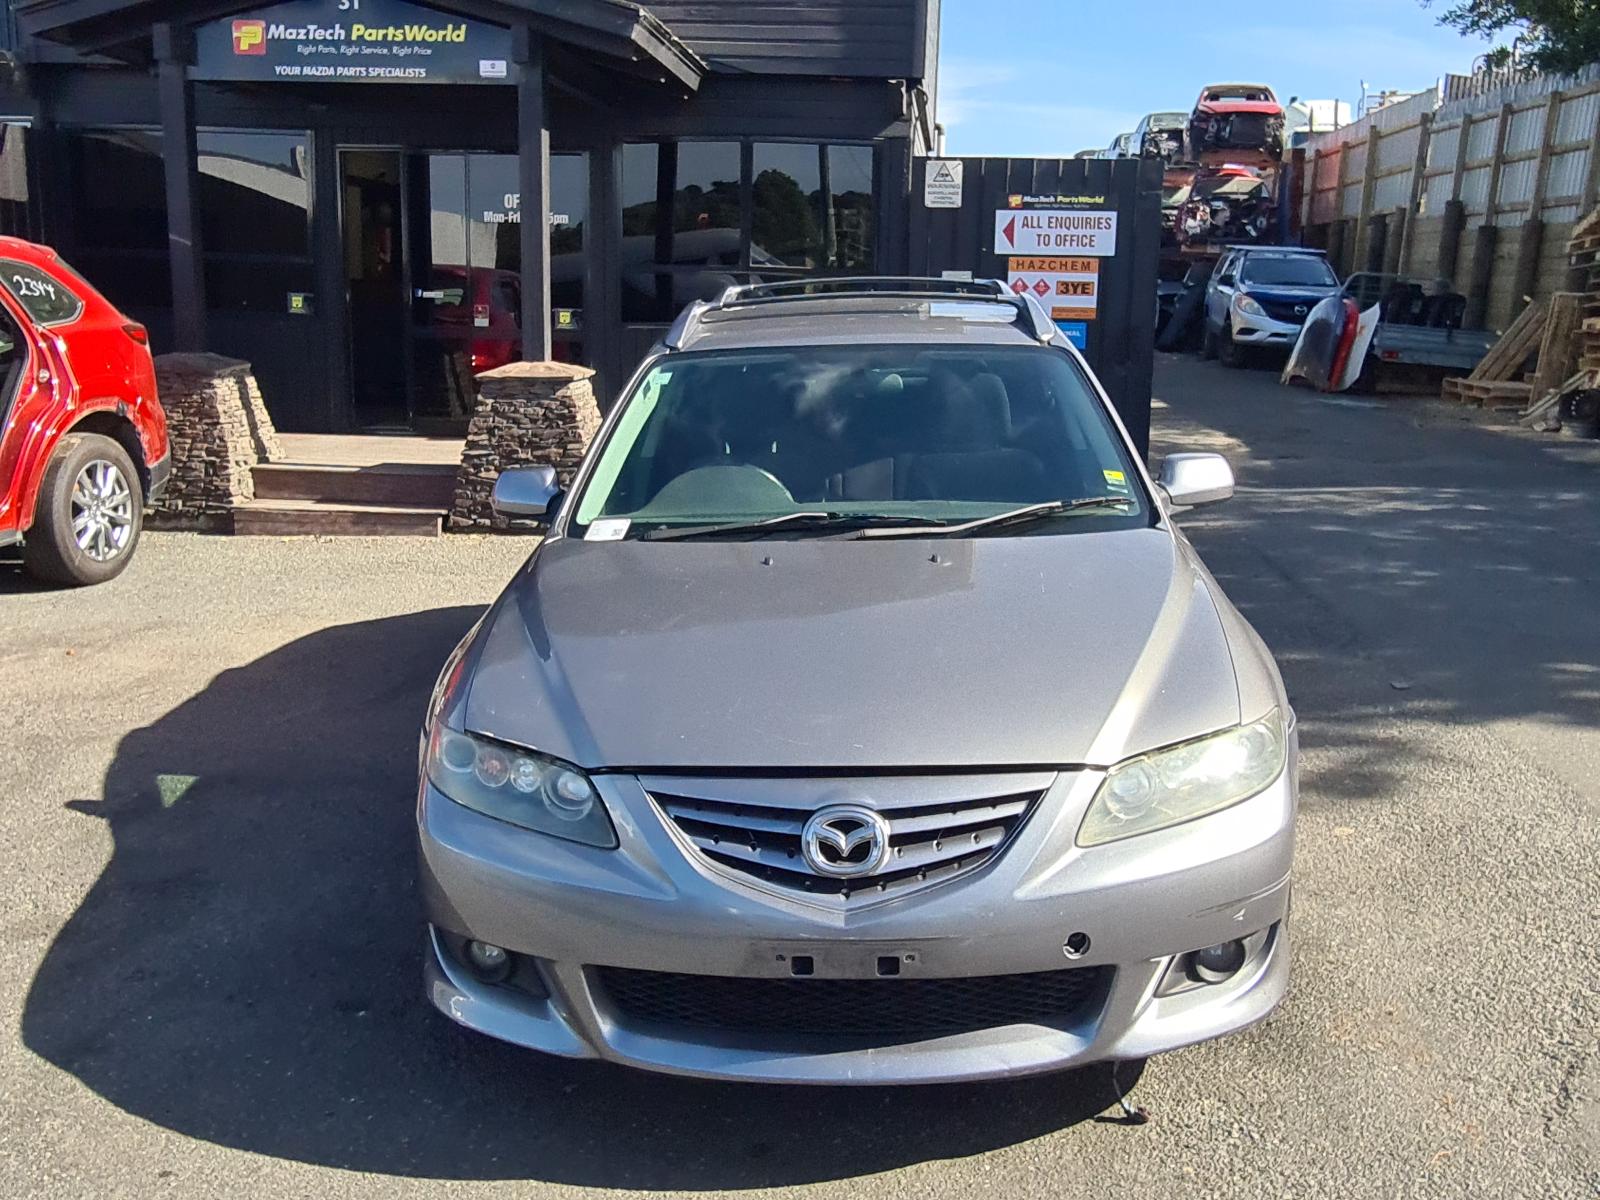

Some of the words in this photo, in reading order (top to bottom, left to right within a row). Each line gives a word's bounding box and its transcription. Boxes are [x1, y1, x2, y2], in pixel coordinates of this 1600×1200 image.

[267, 23, 346, 40] MazTech
[351, 23, 467, 42] PartsWorld
[297, 44, 317, 56] Right
[340, 45, 360, 56] Right
[392, 46, 412, 57] Right
[413, 46, 433, 56] Price
[274, 65, 301, 76] YOUR
[302, 66, 335, 76] MAZDA
[336, 66, 367, 77] PARTS
[367, 67, 427, 78] SPECIALISTS
[503, 193, 521, 209] OF
[1021, 215, 1043, 229] ALL
[1047, 216, 1112, 231] ENQUIRIES
[1036, 233, 1051, 247] TO
[1054, 234, 1096, 248] OFFICE
[1015, 260, 1092, 272] HAZCHEM
[1059, 282, 1091, 295] 3YE
